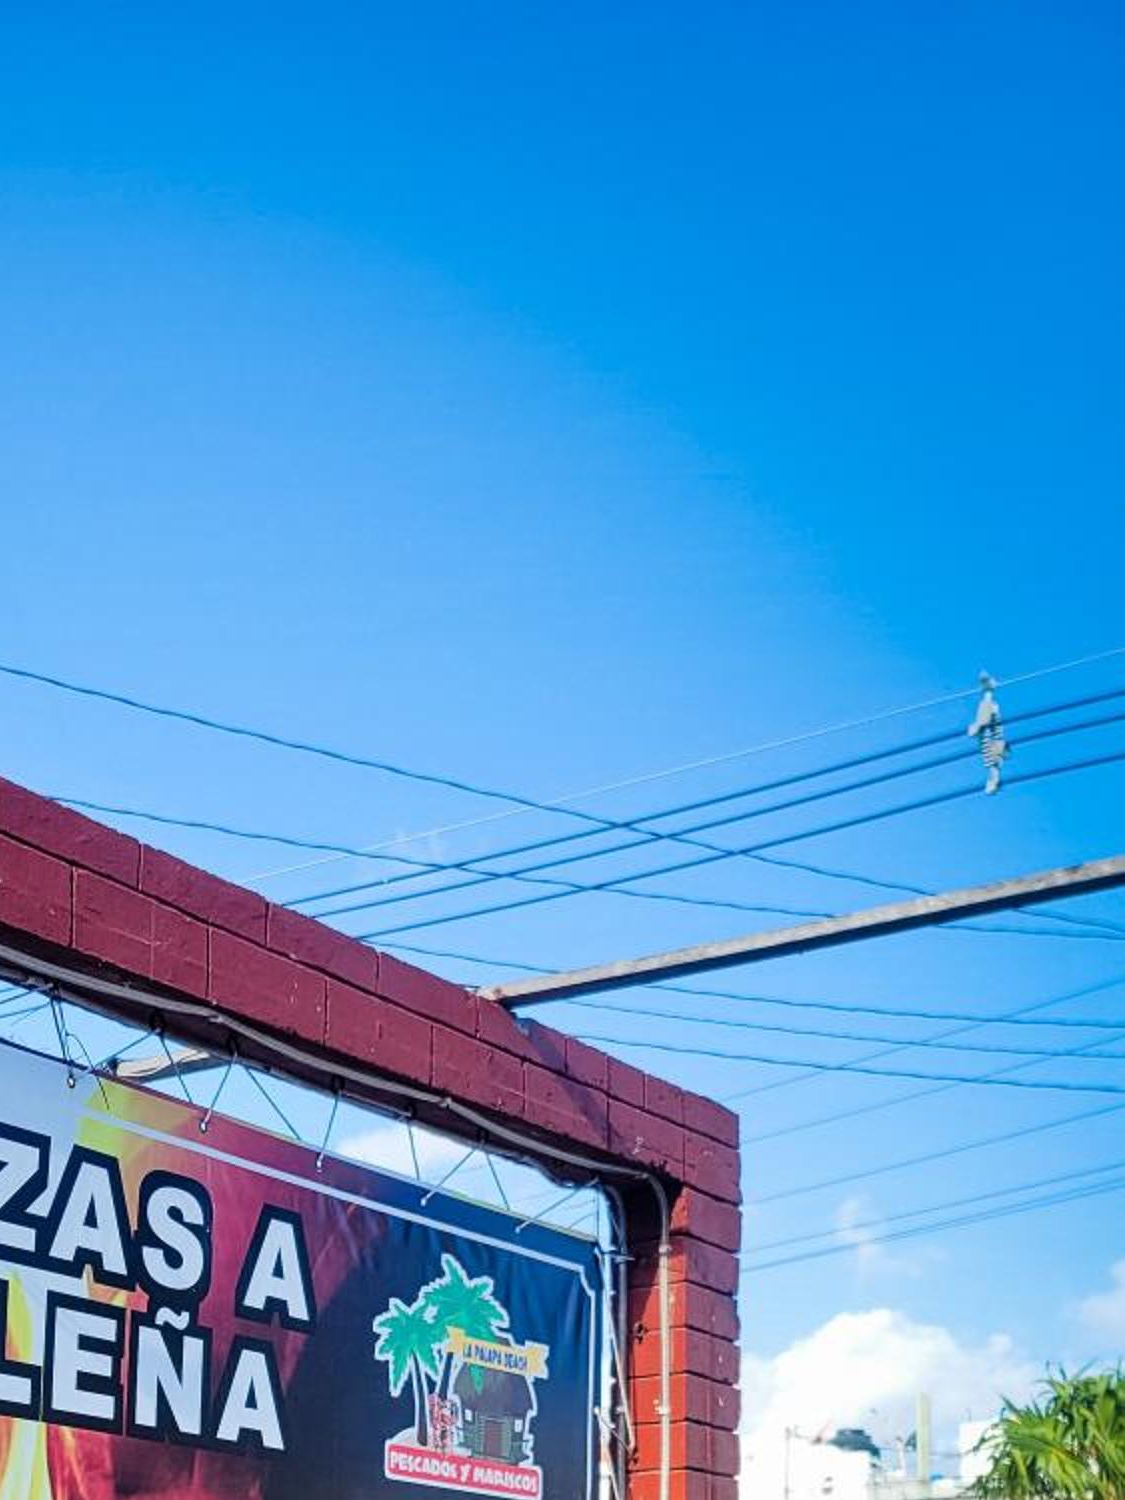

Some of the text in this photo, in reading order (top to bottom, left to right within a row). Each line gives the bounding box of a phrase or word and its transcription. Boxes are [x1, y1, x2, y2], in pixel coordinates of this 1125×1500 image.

[241, 1219, 311, 1322] A
[390, 1451, 538, 1492] PESCADOS Y MARISCOS
